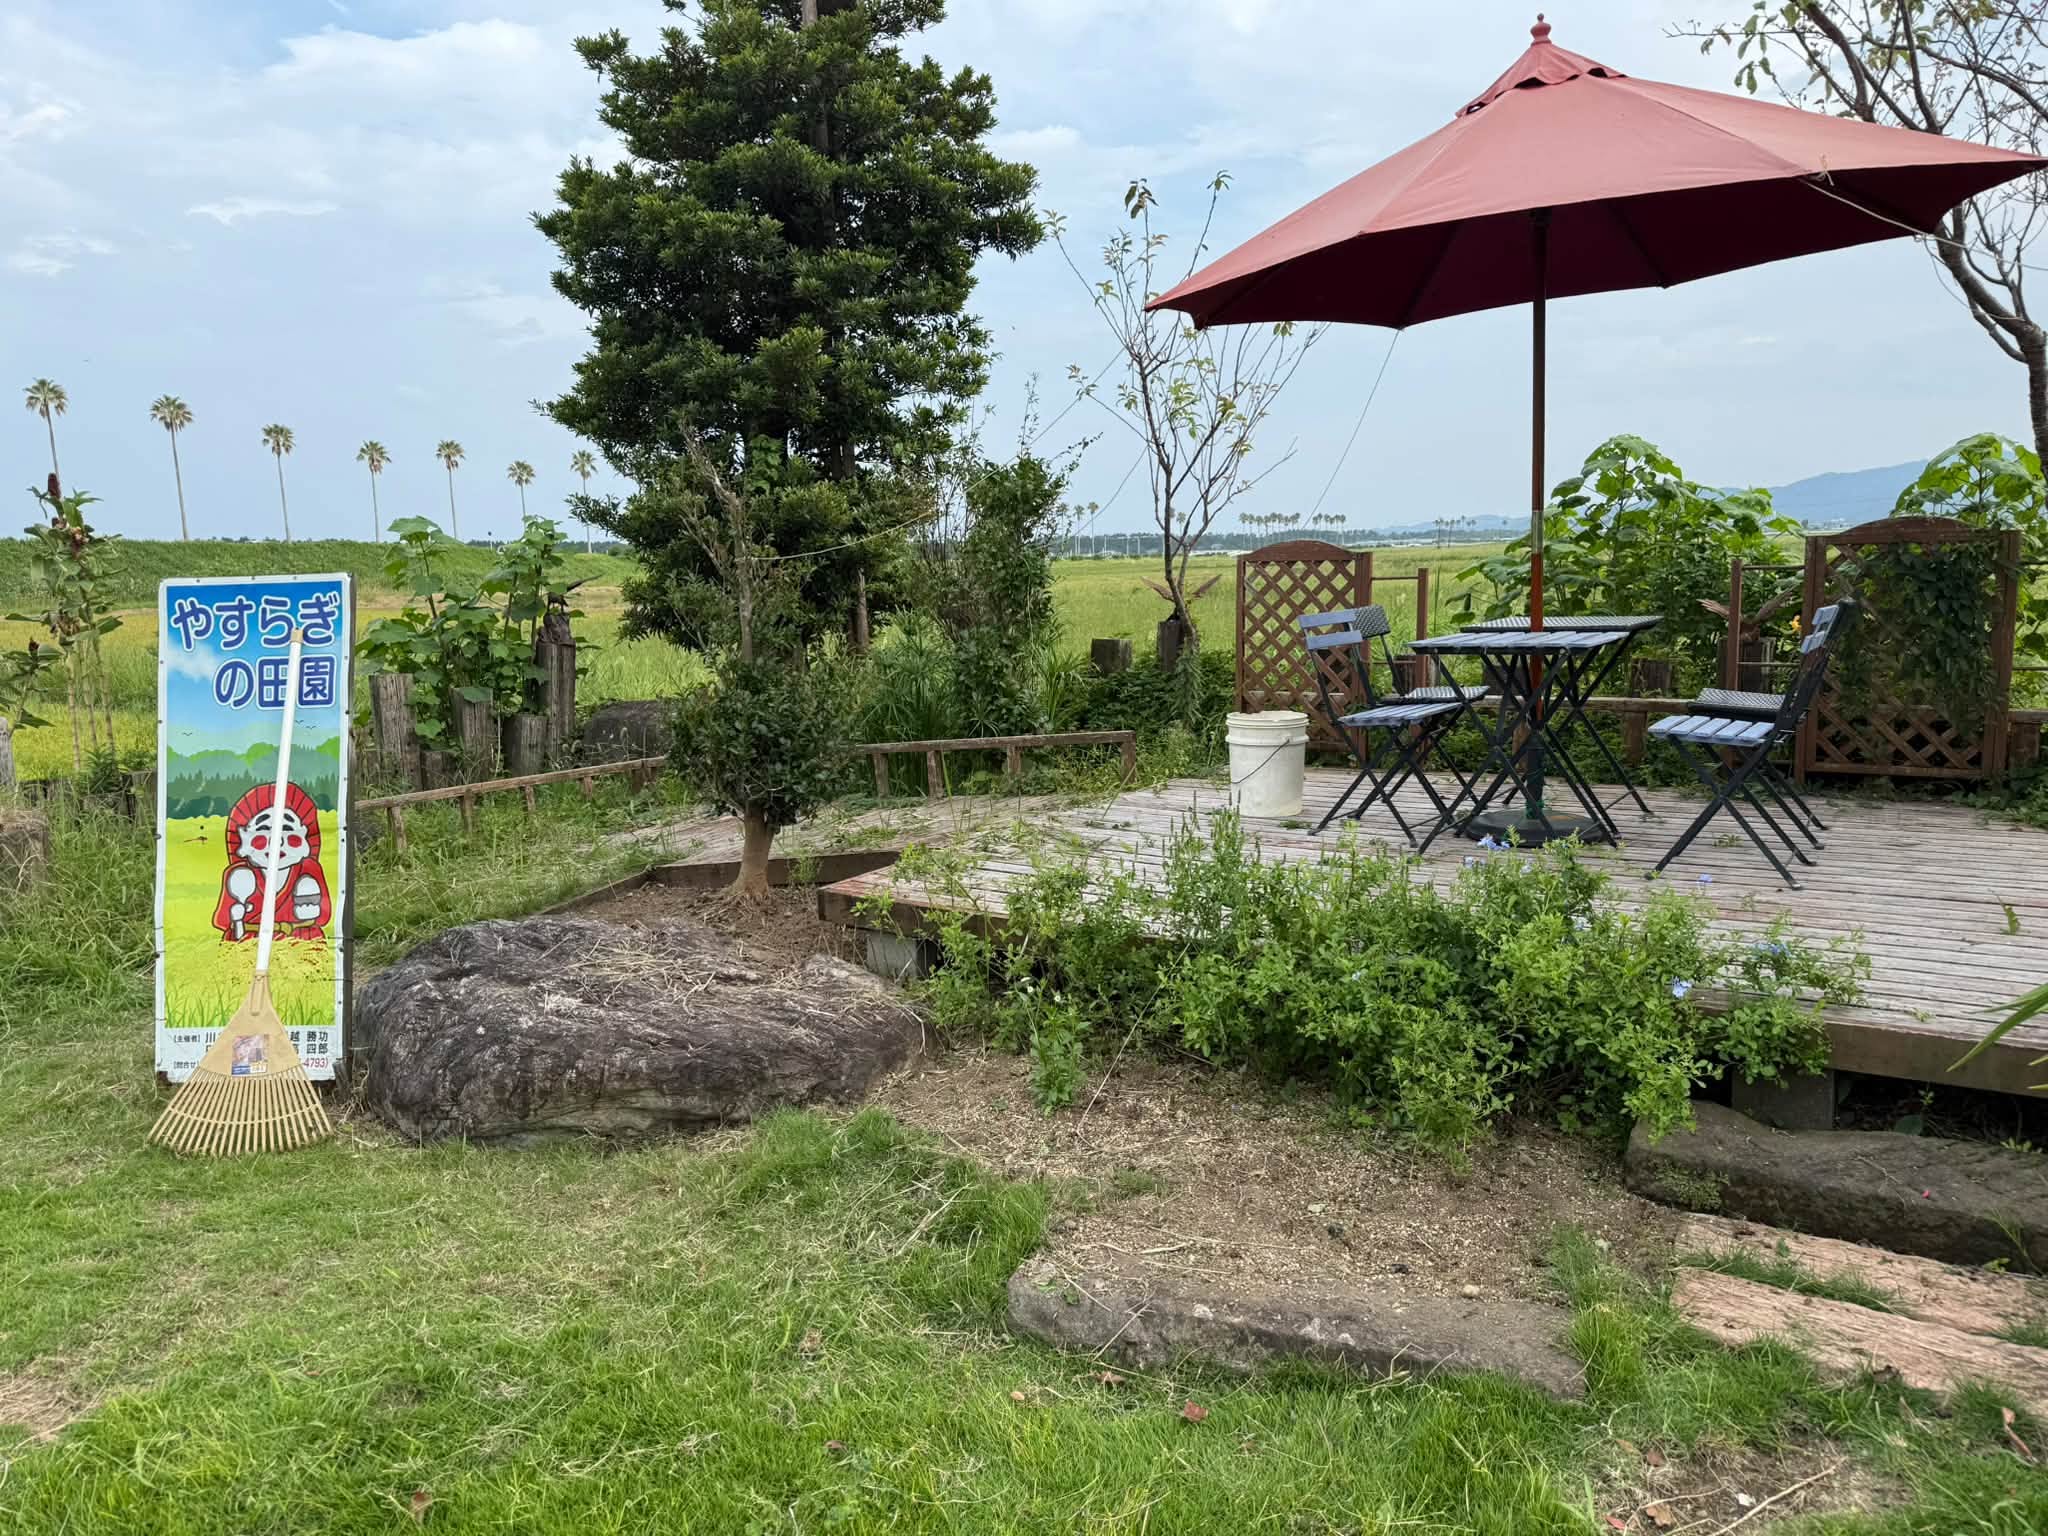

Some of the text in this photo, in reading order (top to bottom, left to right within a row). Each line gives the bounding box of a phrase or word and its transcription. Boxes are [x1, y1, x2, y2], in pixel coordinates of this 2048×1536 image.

[171, 593, 340, 650] やすらぎ
[213, 656, 336, 710] の田園
